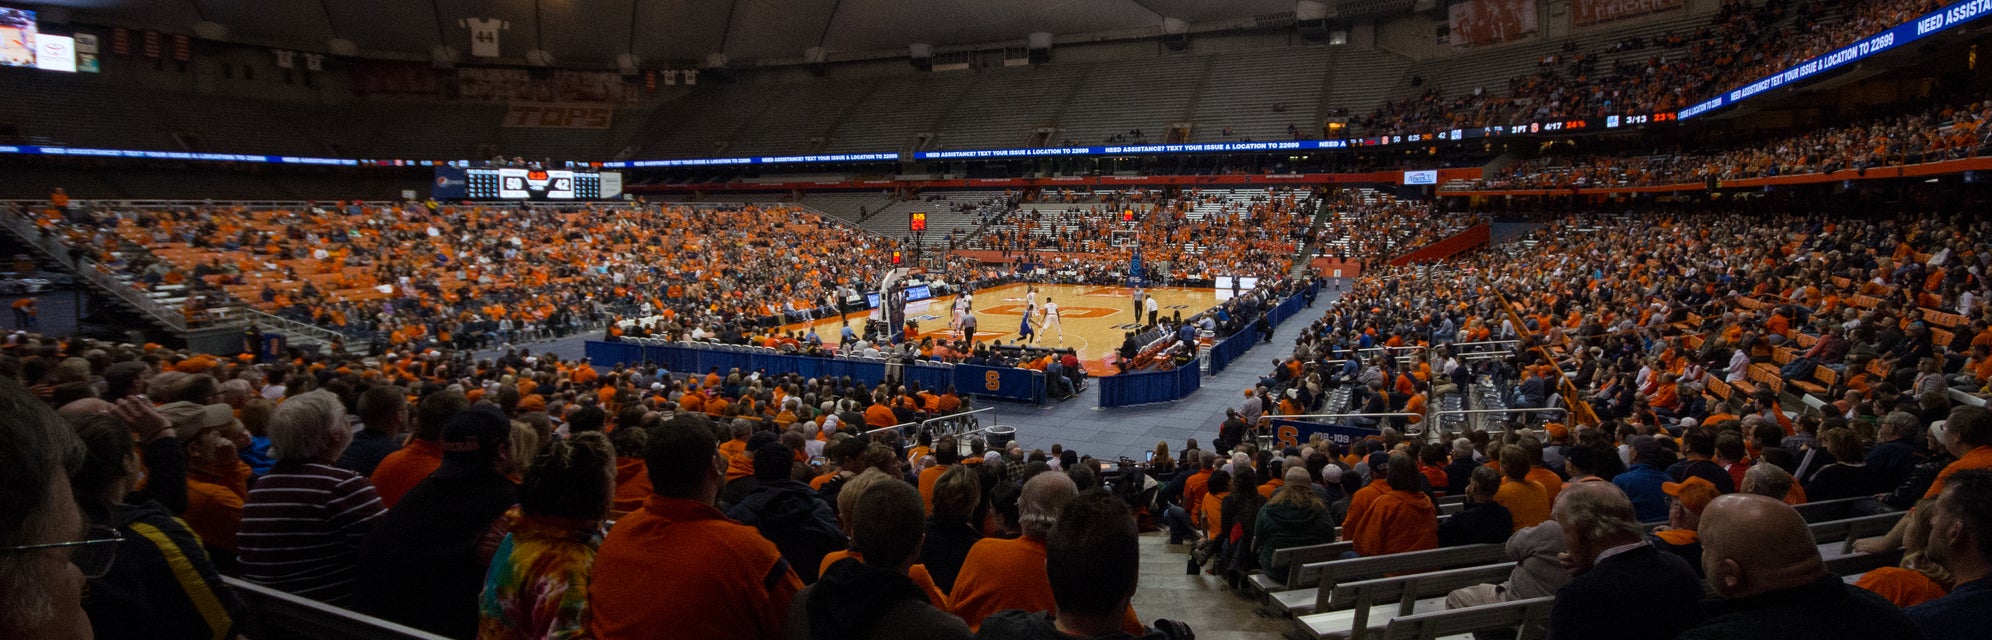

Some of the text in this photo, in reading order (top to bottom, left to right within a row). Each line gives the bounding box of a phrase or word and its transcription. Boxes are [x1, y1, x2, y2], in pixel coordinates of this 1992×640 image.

[1917, 0, 1992, 36] NEED ASSISTA
[475, 30, 495, 44] 44
[1741, 79, 1770, 98] ASSISTANCE?
[1770, 73, 1783, 88] TEXT
[1784, 68, 1799, 82] YOUR
[1799, 60, 1817, 76] ISSUE
[1824, 45, 1858, 69] LOCATION
[1859, 41, 1870, 56] TO
[1870, 32, 1894, 52] 22699
[511, 105, 611, 127] TOPS
[1626, 115, 1647, 124] 3/13
[1544, 122, 1562, 131] 4/17
[1393, 135, 1401, 143] 50
[1408, 134, 1420, 142] 6:25
[506, 177, 570, 190] 50 42
[985, 370, 1000, 391] S
[1277, 425, 1299, 449] S
